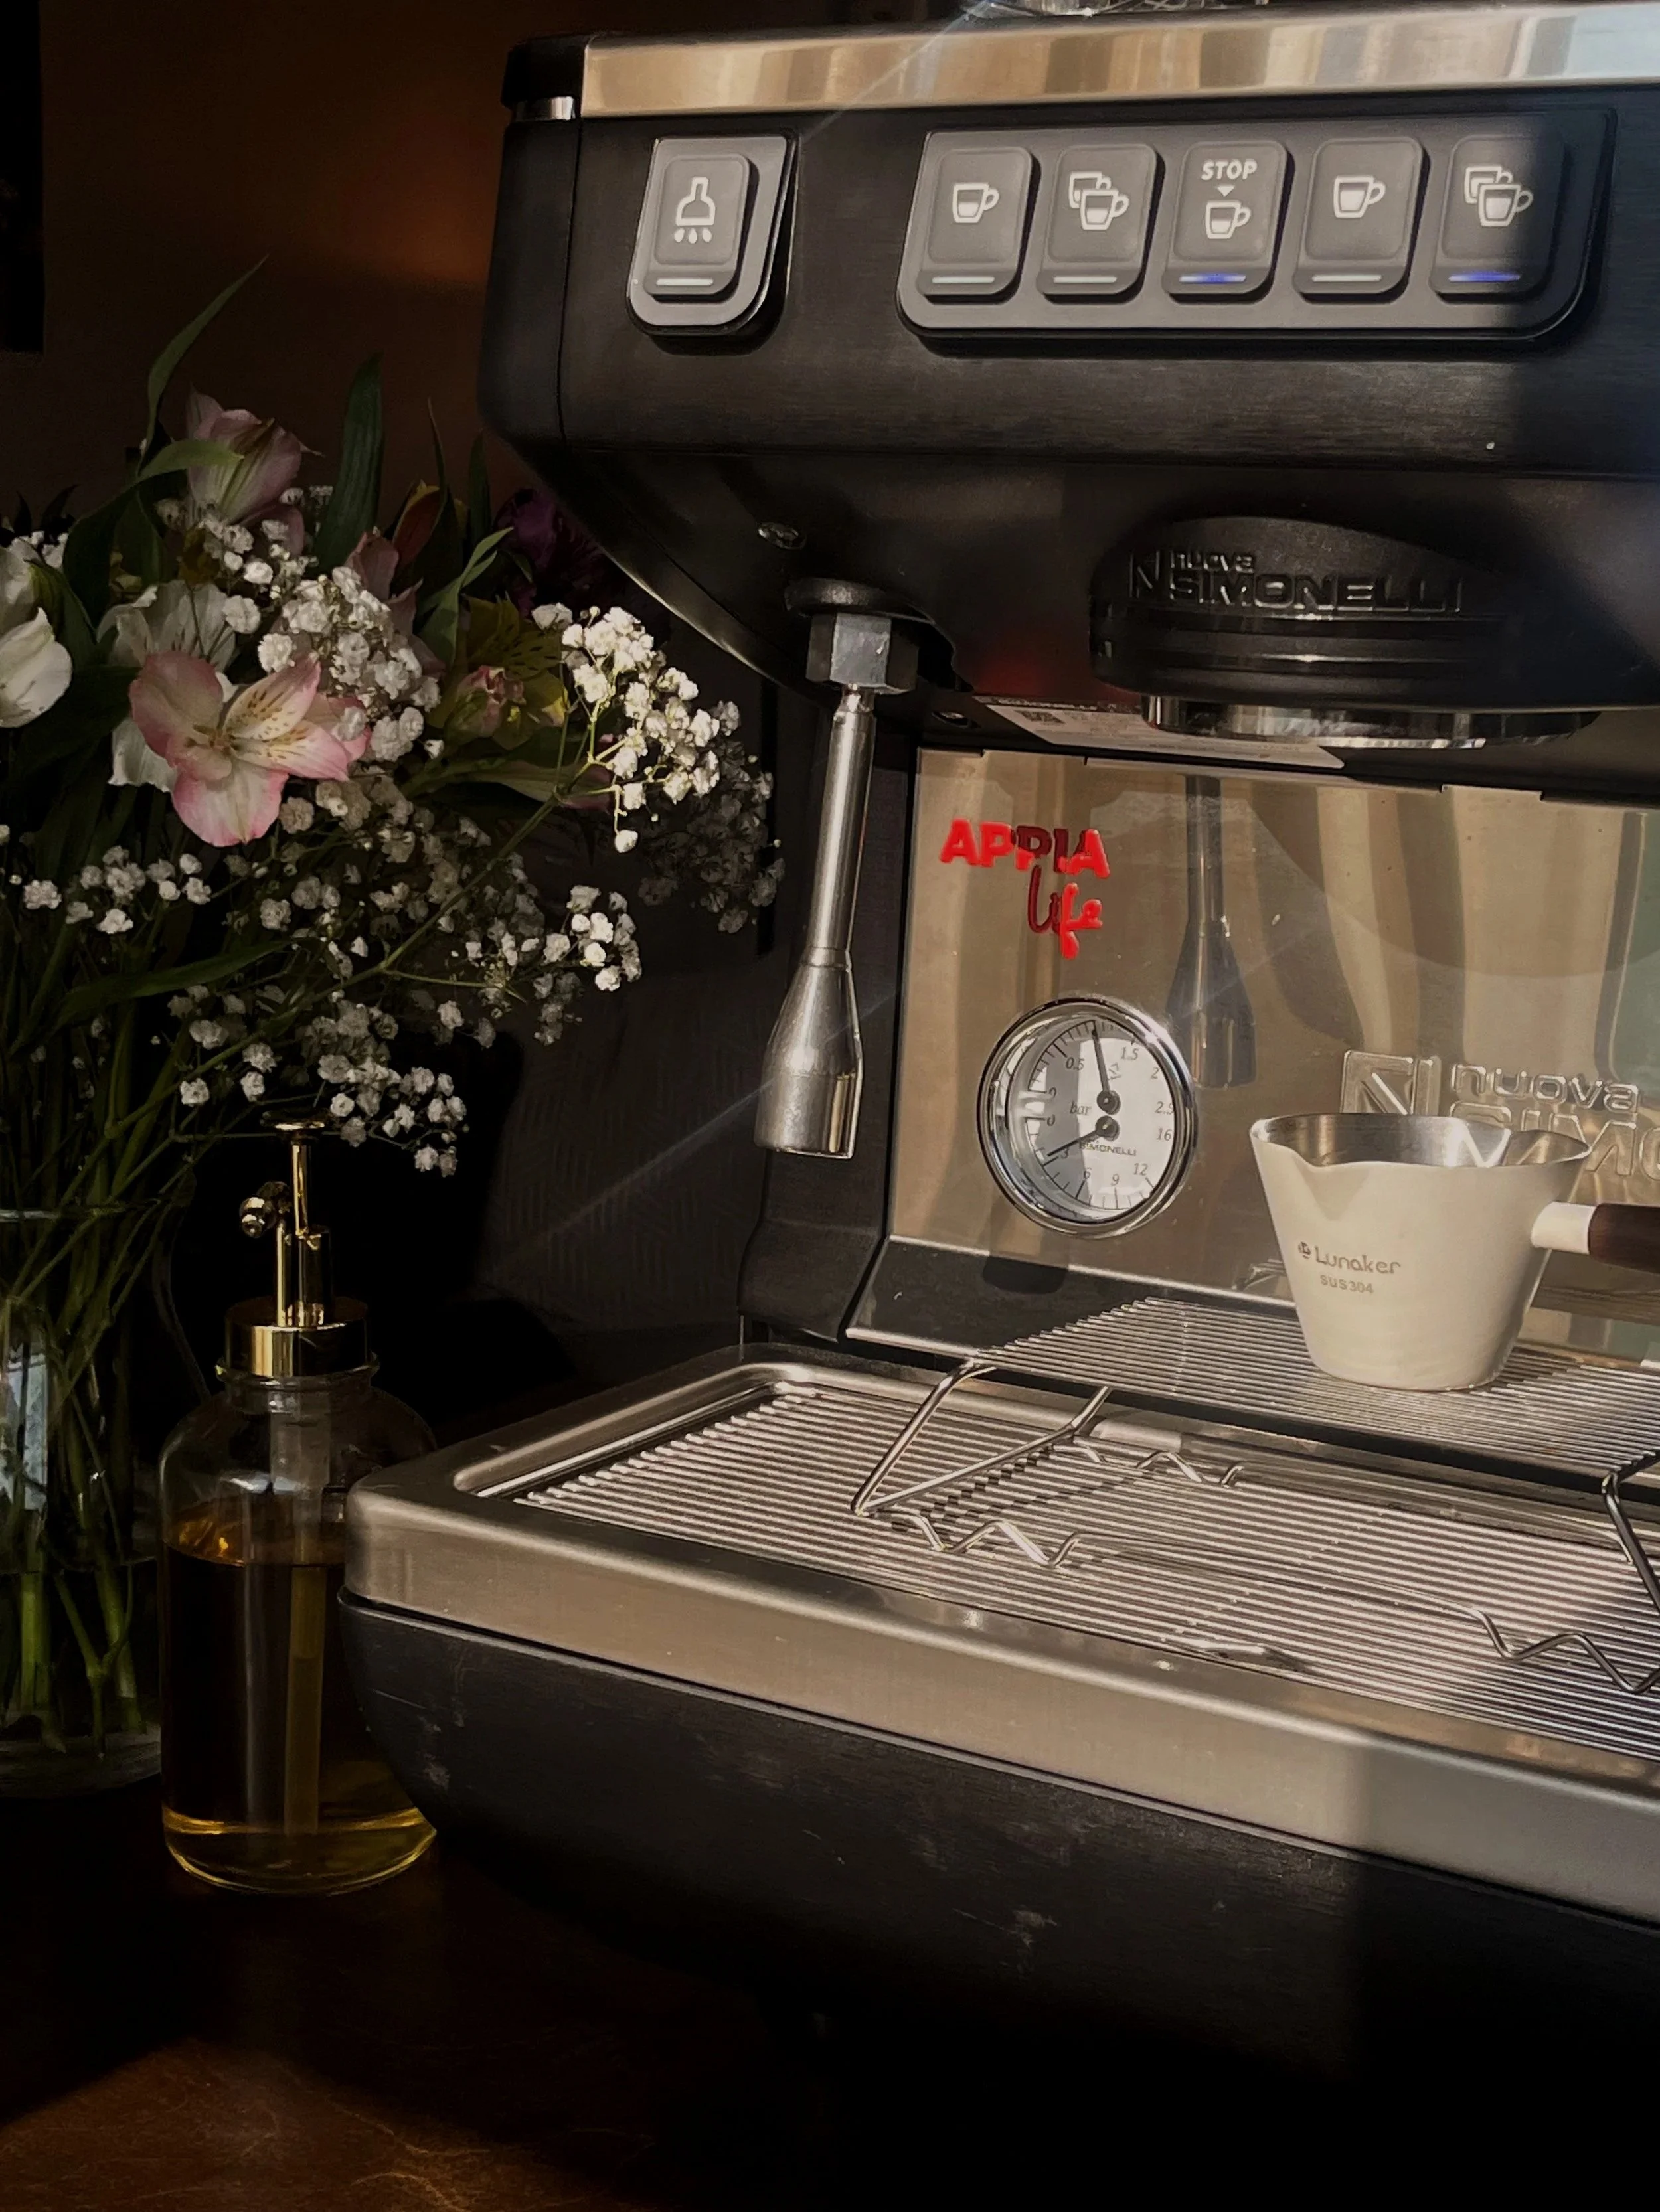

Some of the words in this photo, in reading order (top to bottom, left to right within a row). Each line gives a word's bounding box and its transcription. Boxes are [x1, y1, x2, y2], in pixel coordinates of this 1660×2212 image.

[1201, 158, 1258, 181] STOP
[1169, 571, 1462, 613] SIMONELLI
[939, 817, 1111, 879] APPIA
[1027, 864, 1104, 960] life
[1120, 1046, 1140, 1061] 1.5
[1065, 1056, 1085, 1071] 0.5
[1150, 1066, 1160, 1080] 2
[1450, 1063, 1639, 1113] nuova
[1069, 1100, 1092, 1117] bar
[1156, 1127, 1173, 1142] 16
[1082, 1167, 1092, 1180] 6
[1133, 1162, 1149, 1177] 12
[1110, 1173, 1120, 1187] 9
[1313, 1245, 1402, 1275] Lunaker
[1319, 1273, 1374, 1295] SUS304
